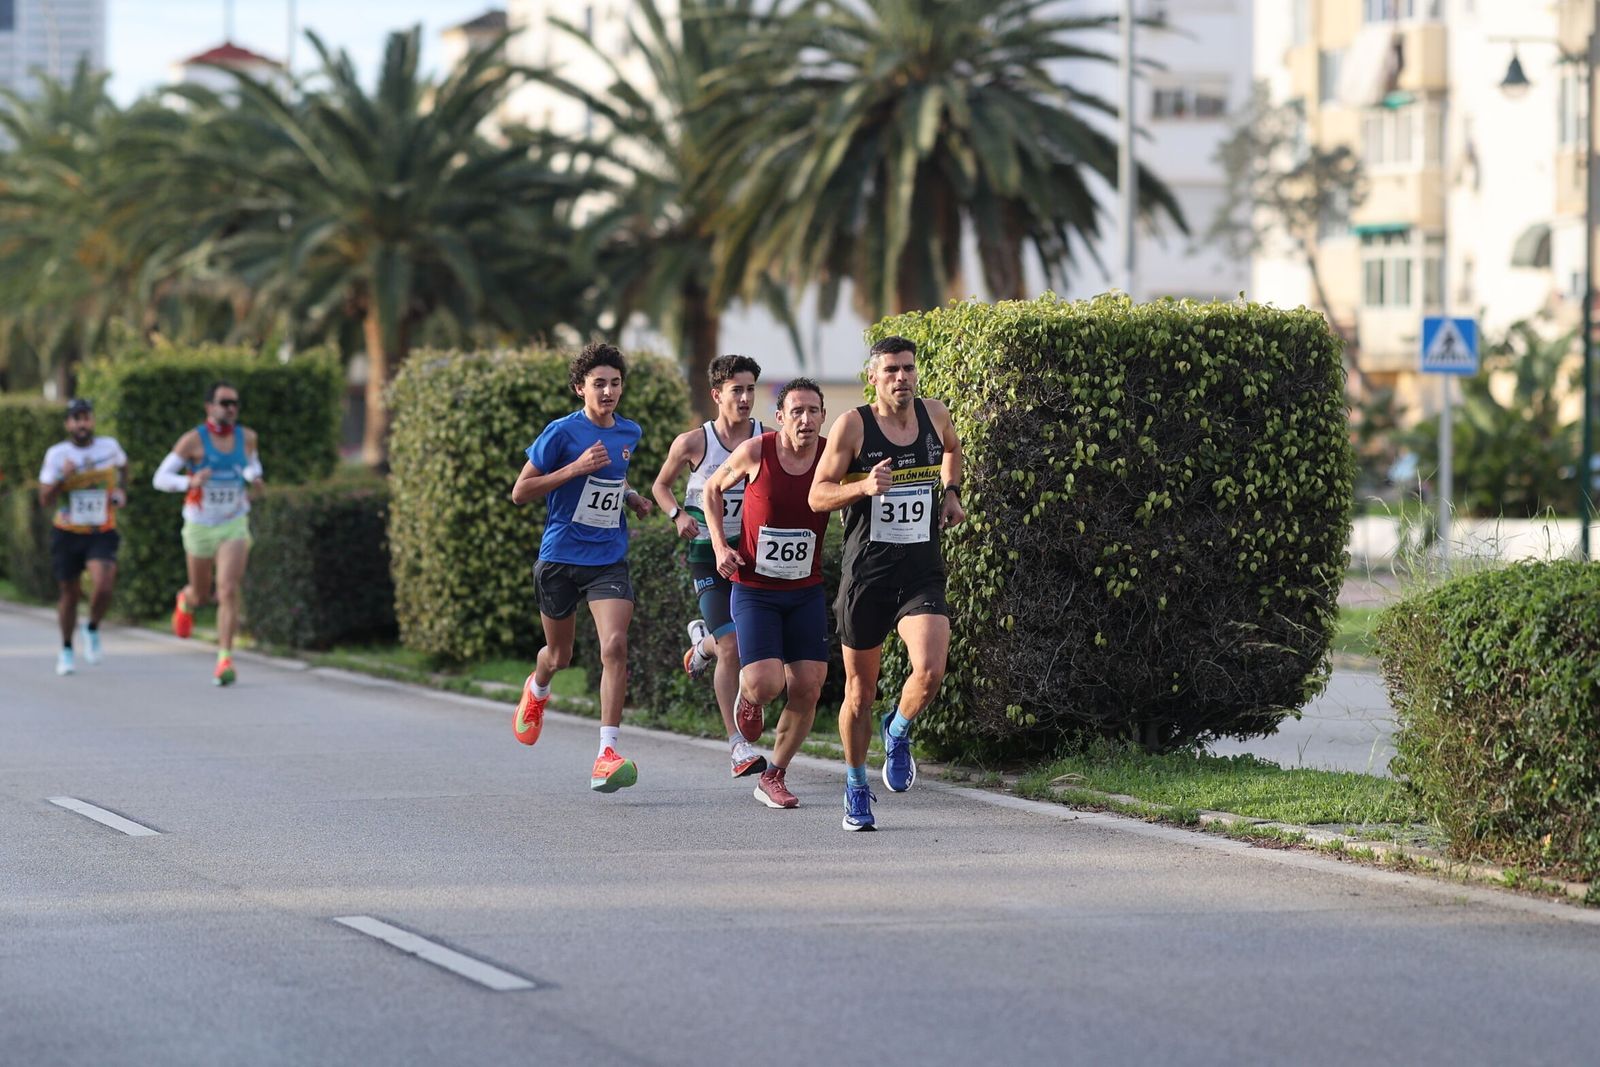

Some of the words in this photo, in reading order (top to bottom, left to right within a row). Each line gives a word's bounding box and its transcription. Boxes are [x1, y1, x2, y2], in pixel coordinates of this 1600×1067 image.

[897, 458, 916, 468] gress
[587, 491, 620, 511] 161
[880, 500, 925, 523] 319
[765, 541, 808, 562] 268
